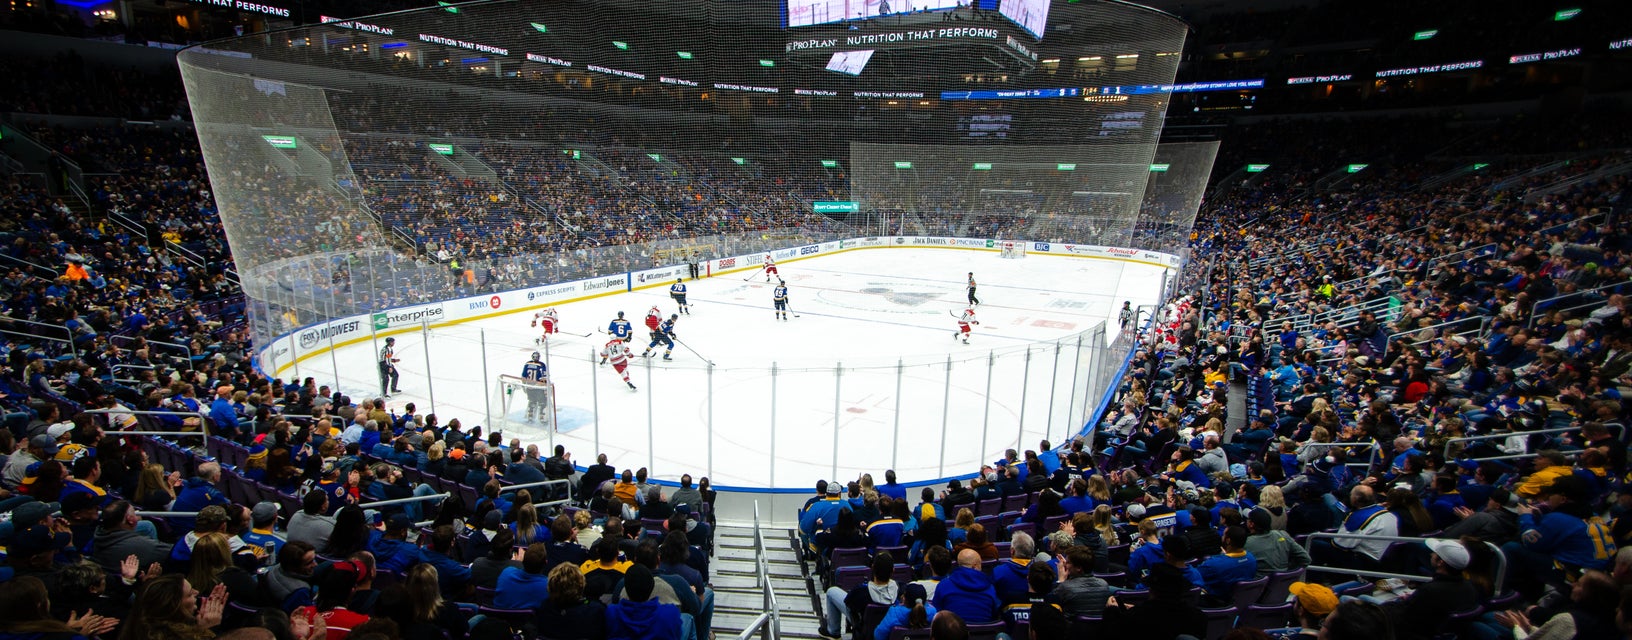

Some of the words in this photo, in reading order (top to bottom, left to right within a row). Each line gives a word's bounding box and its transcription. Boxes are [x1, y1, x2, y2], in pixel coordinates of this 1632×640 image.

[236, 0, 291, 17] PERFORMS
[419, 33, 457, 47] NUTRITION
[458, 40, 475, 49] THAT
[475, 43, 509, 56] PERFORMS
[847, 33, 904, 45] NUTRITION
[907, 29, 936, 40] THAT
[939, 27, 998, 39] PERFORMS
[1376, 67, 1417, 77] NUTRITION
[1419, 65, 1440, 73] THAT
[1440, 60, 1483, 72] PERFORMS
[800, 245, 819, 255] GEICO
[469, 300, 488, 310] BMO
[375, 306, 443, 326] enterprise
[303, 332, 315, 341] FOX
[617, 325, 624, 335] 6
